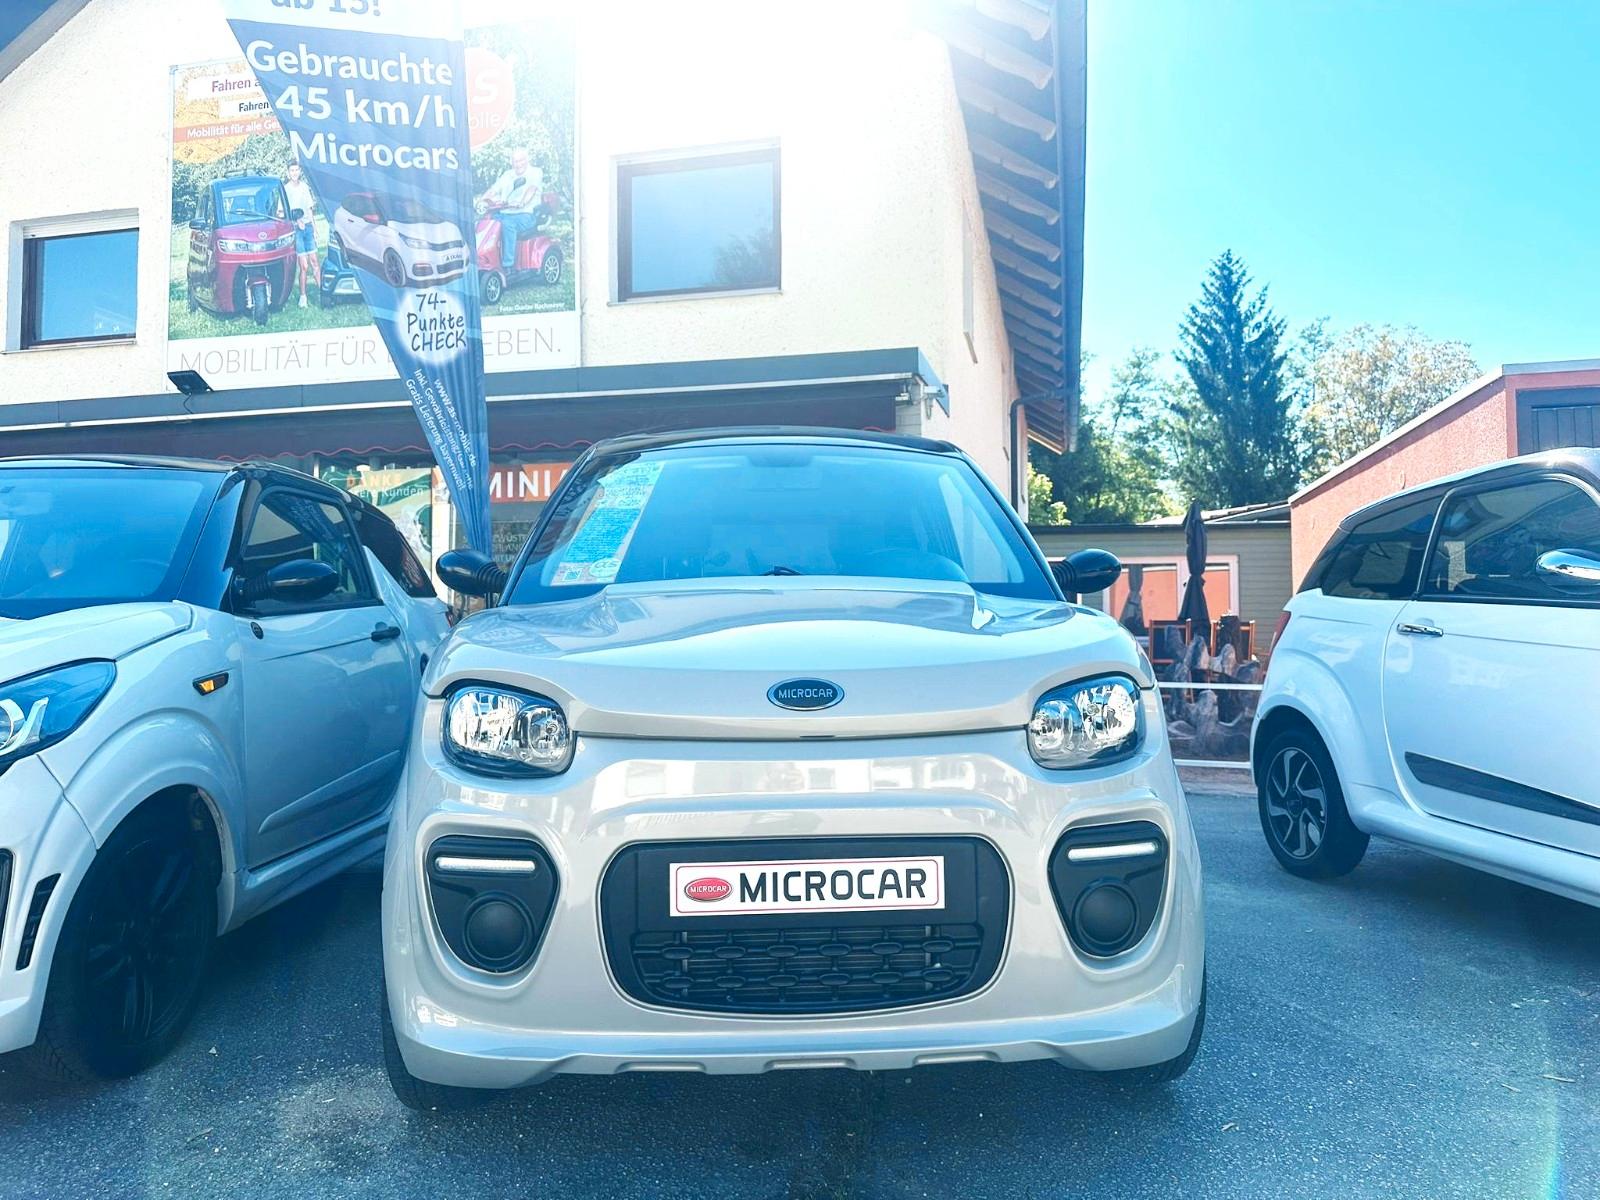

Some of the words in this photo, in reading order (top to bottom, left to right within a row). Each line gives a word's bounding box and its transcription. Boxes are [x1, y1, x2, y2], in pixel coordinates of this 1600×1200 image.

[246, 39, 453, 87] Gebrauchte
[212, 79, 251, 93] Fahren
[239, 101, 269, 112] Fahren
[275, 86, 331, 121] 45
[345, 88, 456, 129] km/h
[187, 125, 229, 138] Mobilität
[231, 123, 243, 133] für
[245, 121, 262, 131] alle
[290, 131, 459, 170] Microcars
[416, 292, 447, 312] 74-
[407, 312, 464, 334] Punkte
[180, 339, 317, 375] MOBILITÄT
[324, 336, 376, 367] FÜR
[481, 327, 561, 357] EBEN.
[411, 329, 467, 352] CHECK
[406, 379, 423, 405] Gratis
[420, 404, 443, 446] Lieferung
[440, 443, 467, 490] bayernweit
[382, 486, 424, 498] Kunden
[489, 469, 568, 499] MINI
[778, 688, 833, 699] MICROCAR
[690, 884, 728, 893] MICROCAR
[739, 868, 927, 903] MICROCAR
